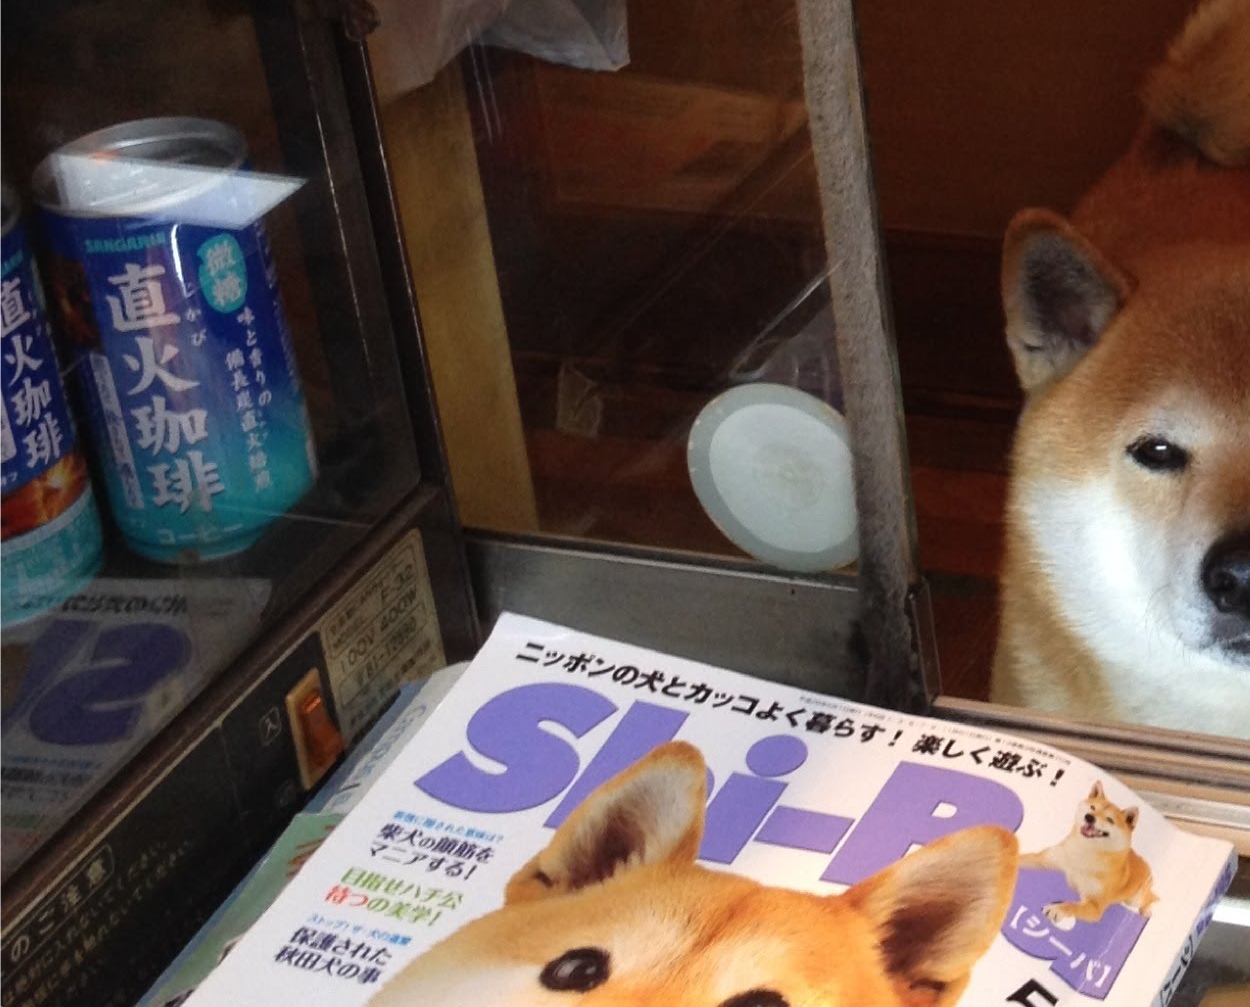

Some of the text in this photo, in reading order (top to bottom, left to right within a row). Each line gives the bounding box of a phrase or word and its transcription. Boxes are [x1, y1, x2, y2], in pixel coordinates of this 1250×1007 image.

[105, 261, 226, 515] 直火珈琲
[515, 641, 904, 748] ニッポンの犬とカッコよく暮らす！
[911, 733, 1066, 788] 楽しく遊ぶ！
[369, 843, 478, 882] マニアする！
[324, 884, 442, 928] 待つの美学！
[340, 866, 464, 911] 目指せハチ公
[274, 944, 382, 986] 秋田犬の事
[289, 926, 393, 966] 保護された
